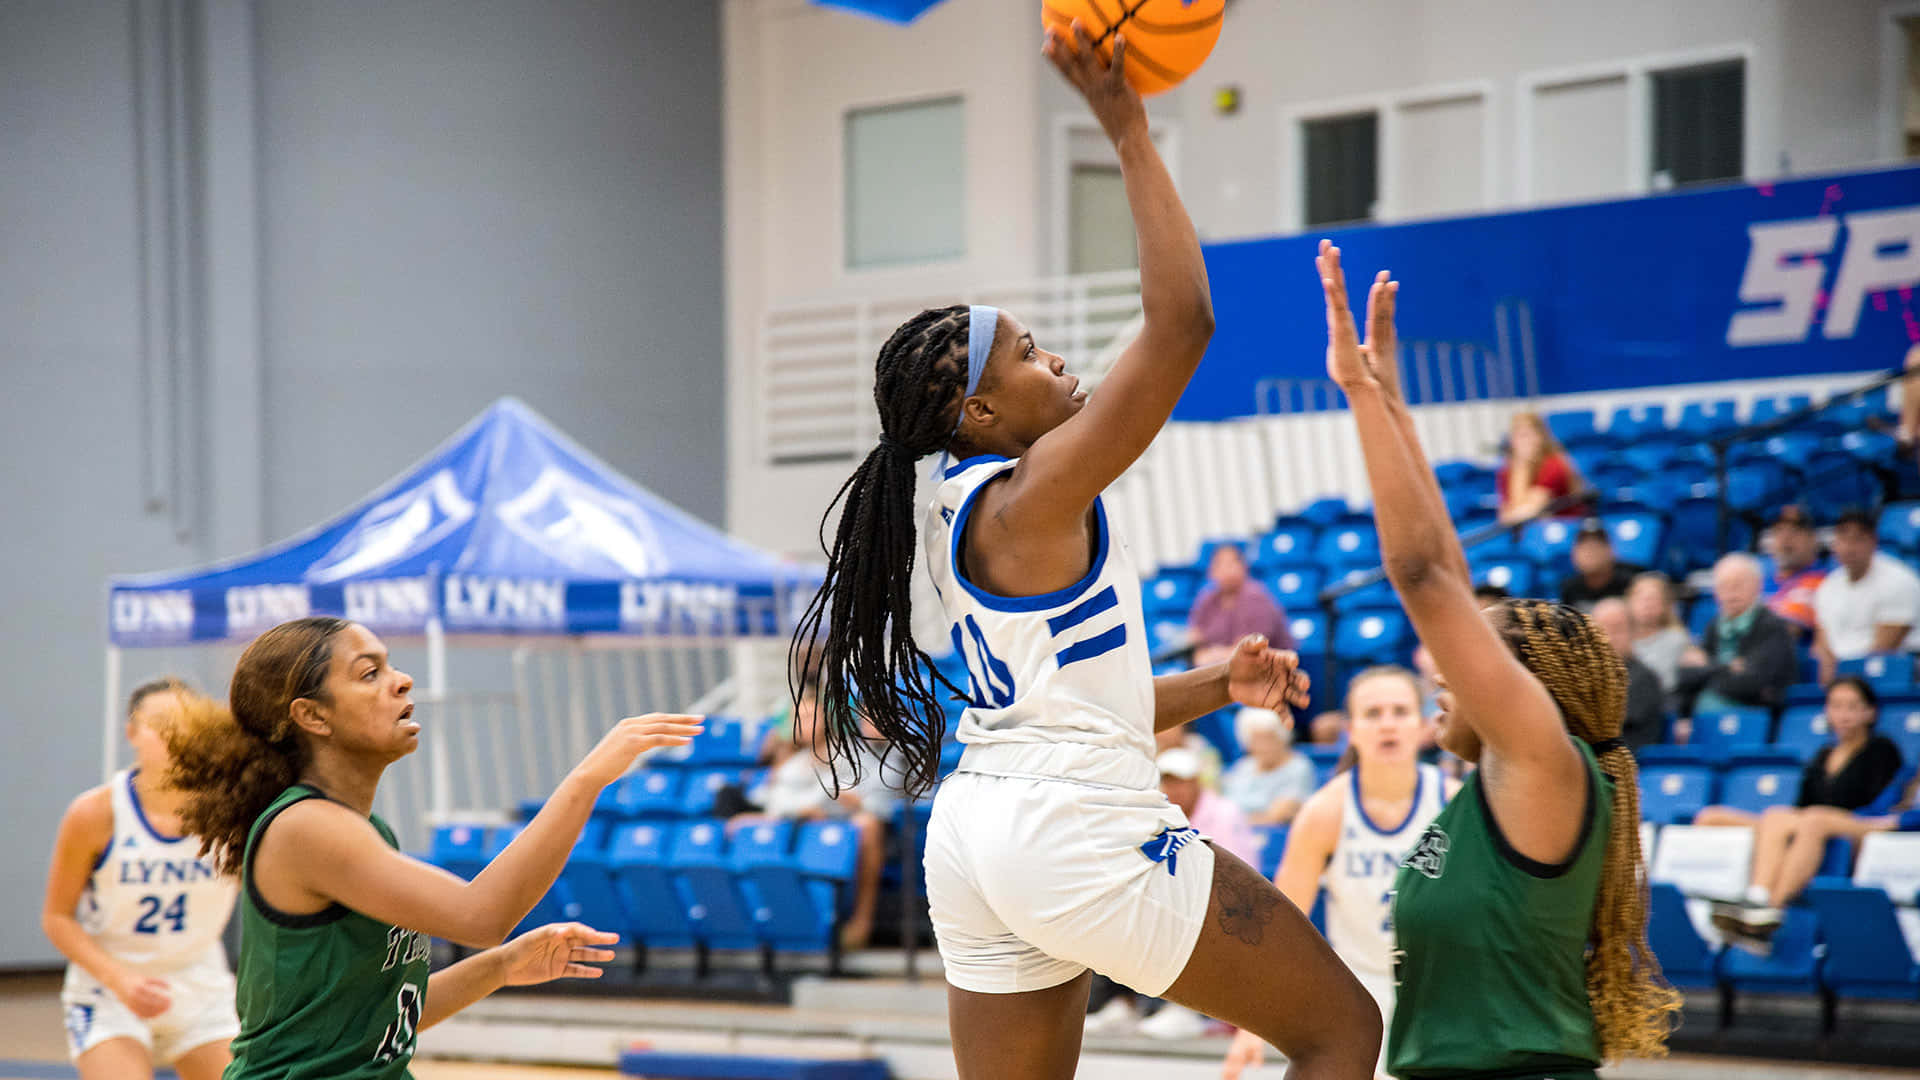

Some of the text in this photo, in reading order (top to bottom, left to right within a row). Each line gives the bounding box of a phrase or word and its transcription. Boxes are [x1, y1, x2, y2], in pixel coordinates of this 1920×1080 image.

[446, 574, 564, 621] LYNN
[120, 858, 215, 884] LYNN
[133, 892, 188, 934] 24
